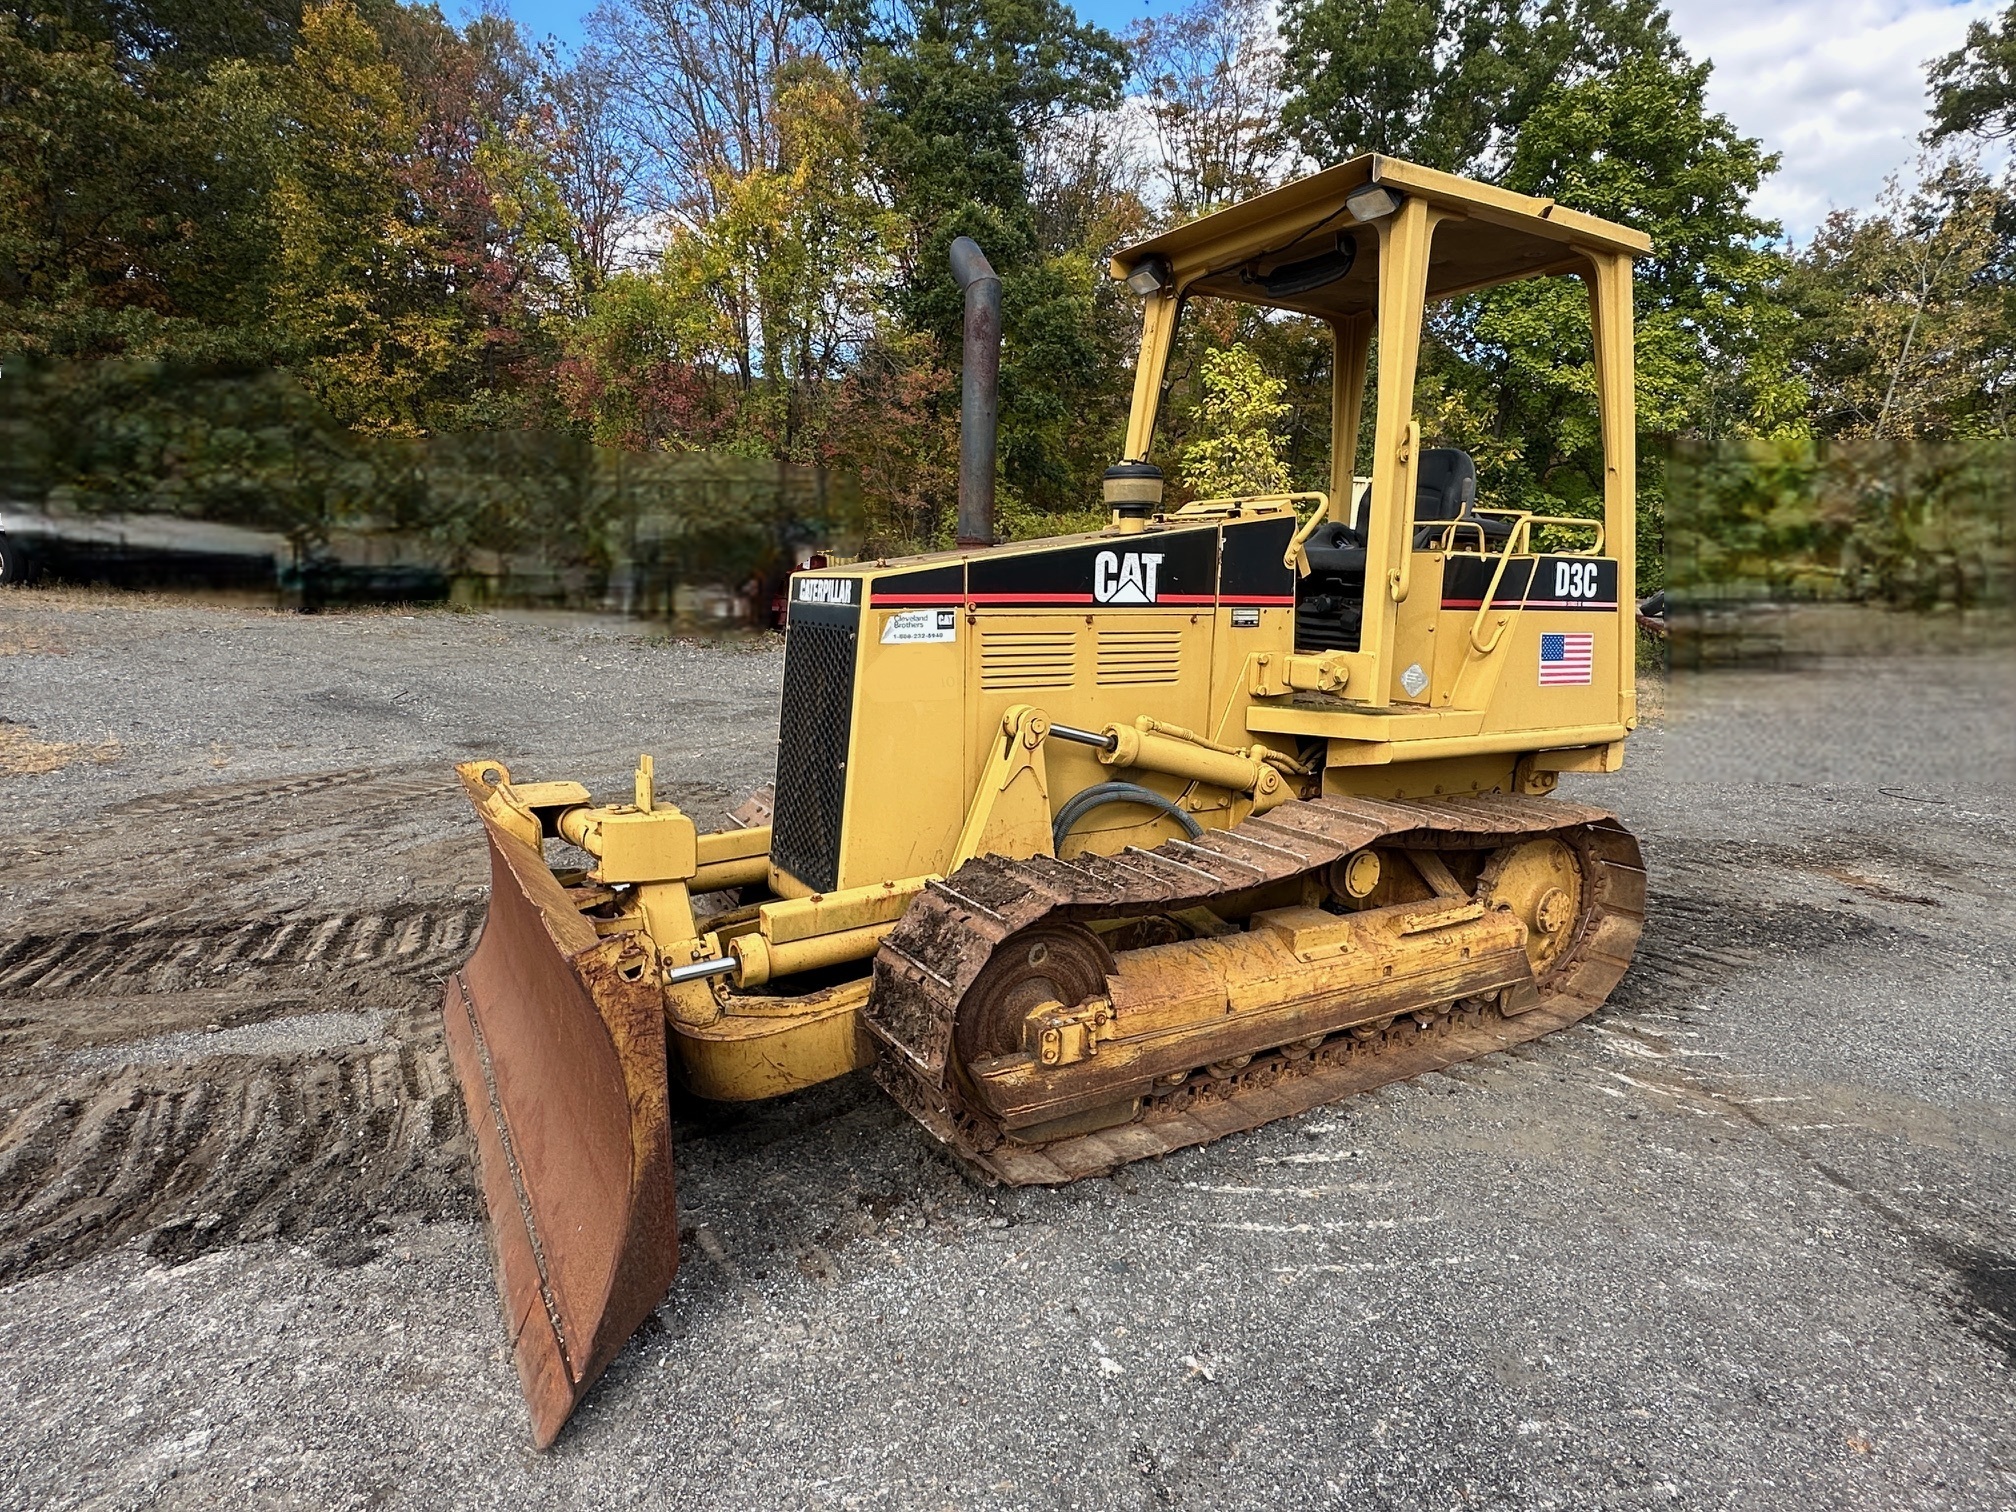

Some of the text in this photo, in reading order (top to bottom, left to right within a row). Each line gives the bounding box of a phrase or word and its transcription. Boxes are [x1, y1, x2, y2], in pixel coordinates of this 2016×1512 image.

[1094, 551, 1162, 602] CAT
[1555, 562, 1598, 598] D3C
[799, 579, 852, 603] CATERPILLAR
[893, 614, 928, 622] Cleveland
[893, 621, 924, 629] Brothers
